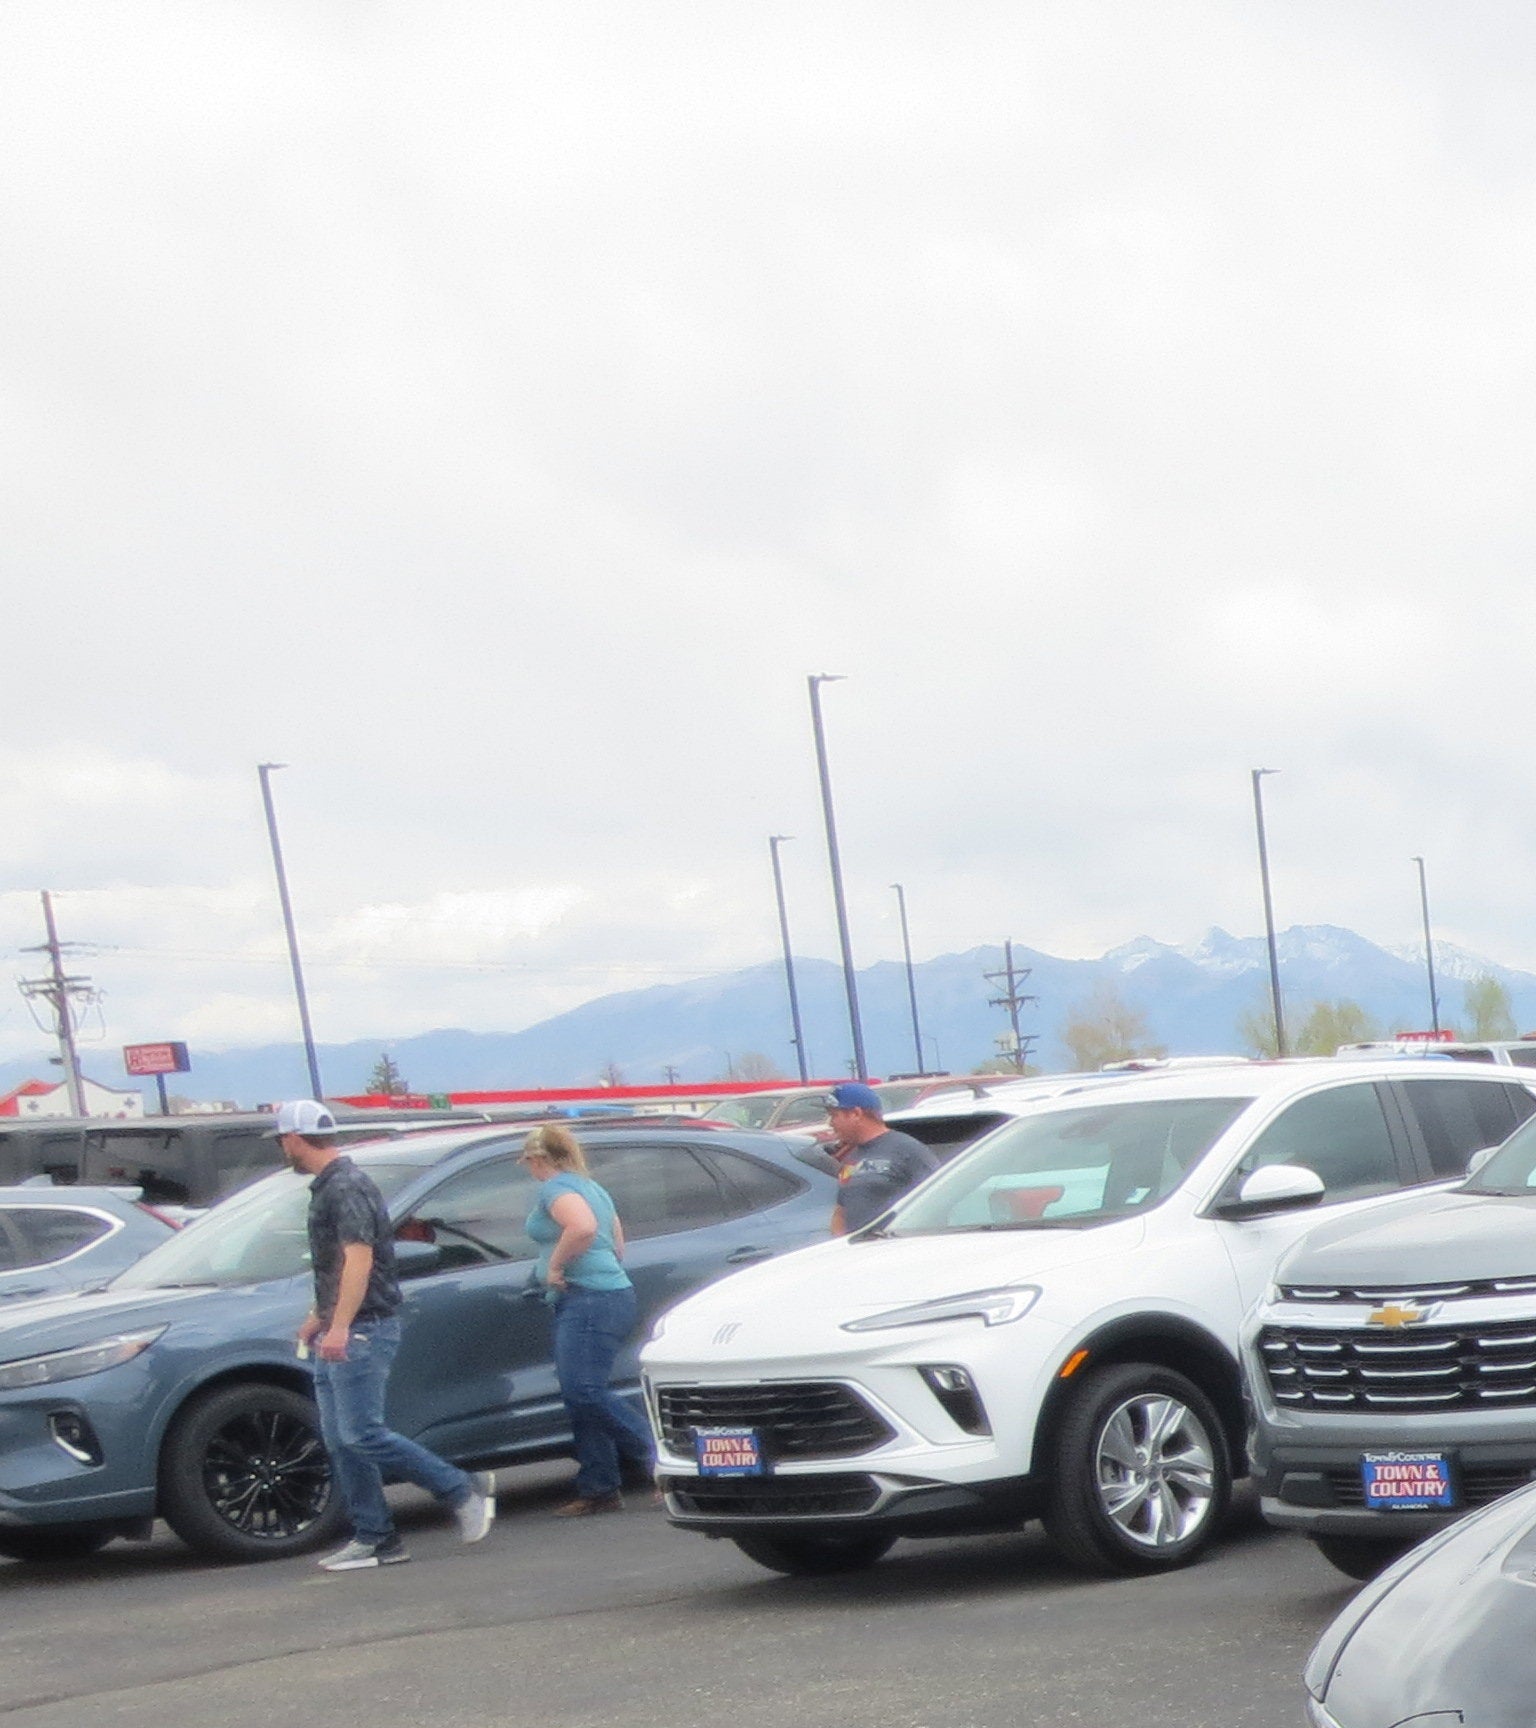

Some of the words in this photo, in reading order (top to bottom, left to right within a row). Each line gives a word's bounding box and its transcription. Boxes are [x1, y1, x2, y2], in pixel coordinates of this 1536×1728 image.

[704, 1438, 742, 1452] TOWN
[742, 1437, 753, 1451] &
[702, 1452, 758, 1467] COUNTRY
[1374, 1465, 1423, 1481] TOWN
[1426, 1464, 1439, 1480] &
[1370, 1480, 1447, 1497] COUNTRY
